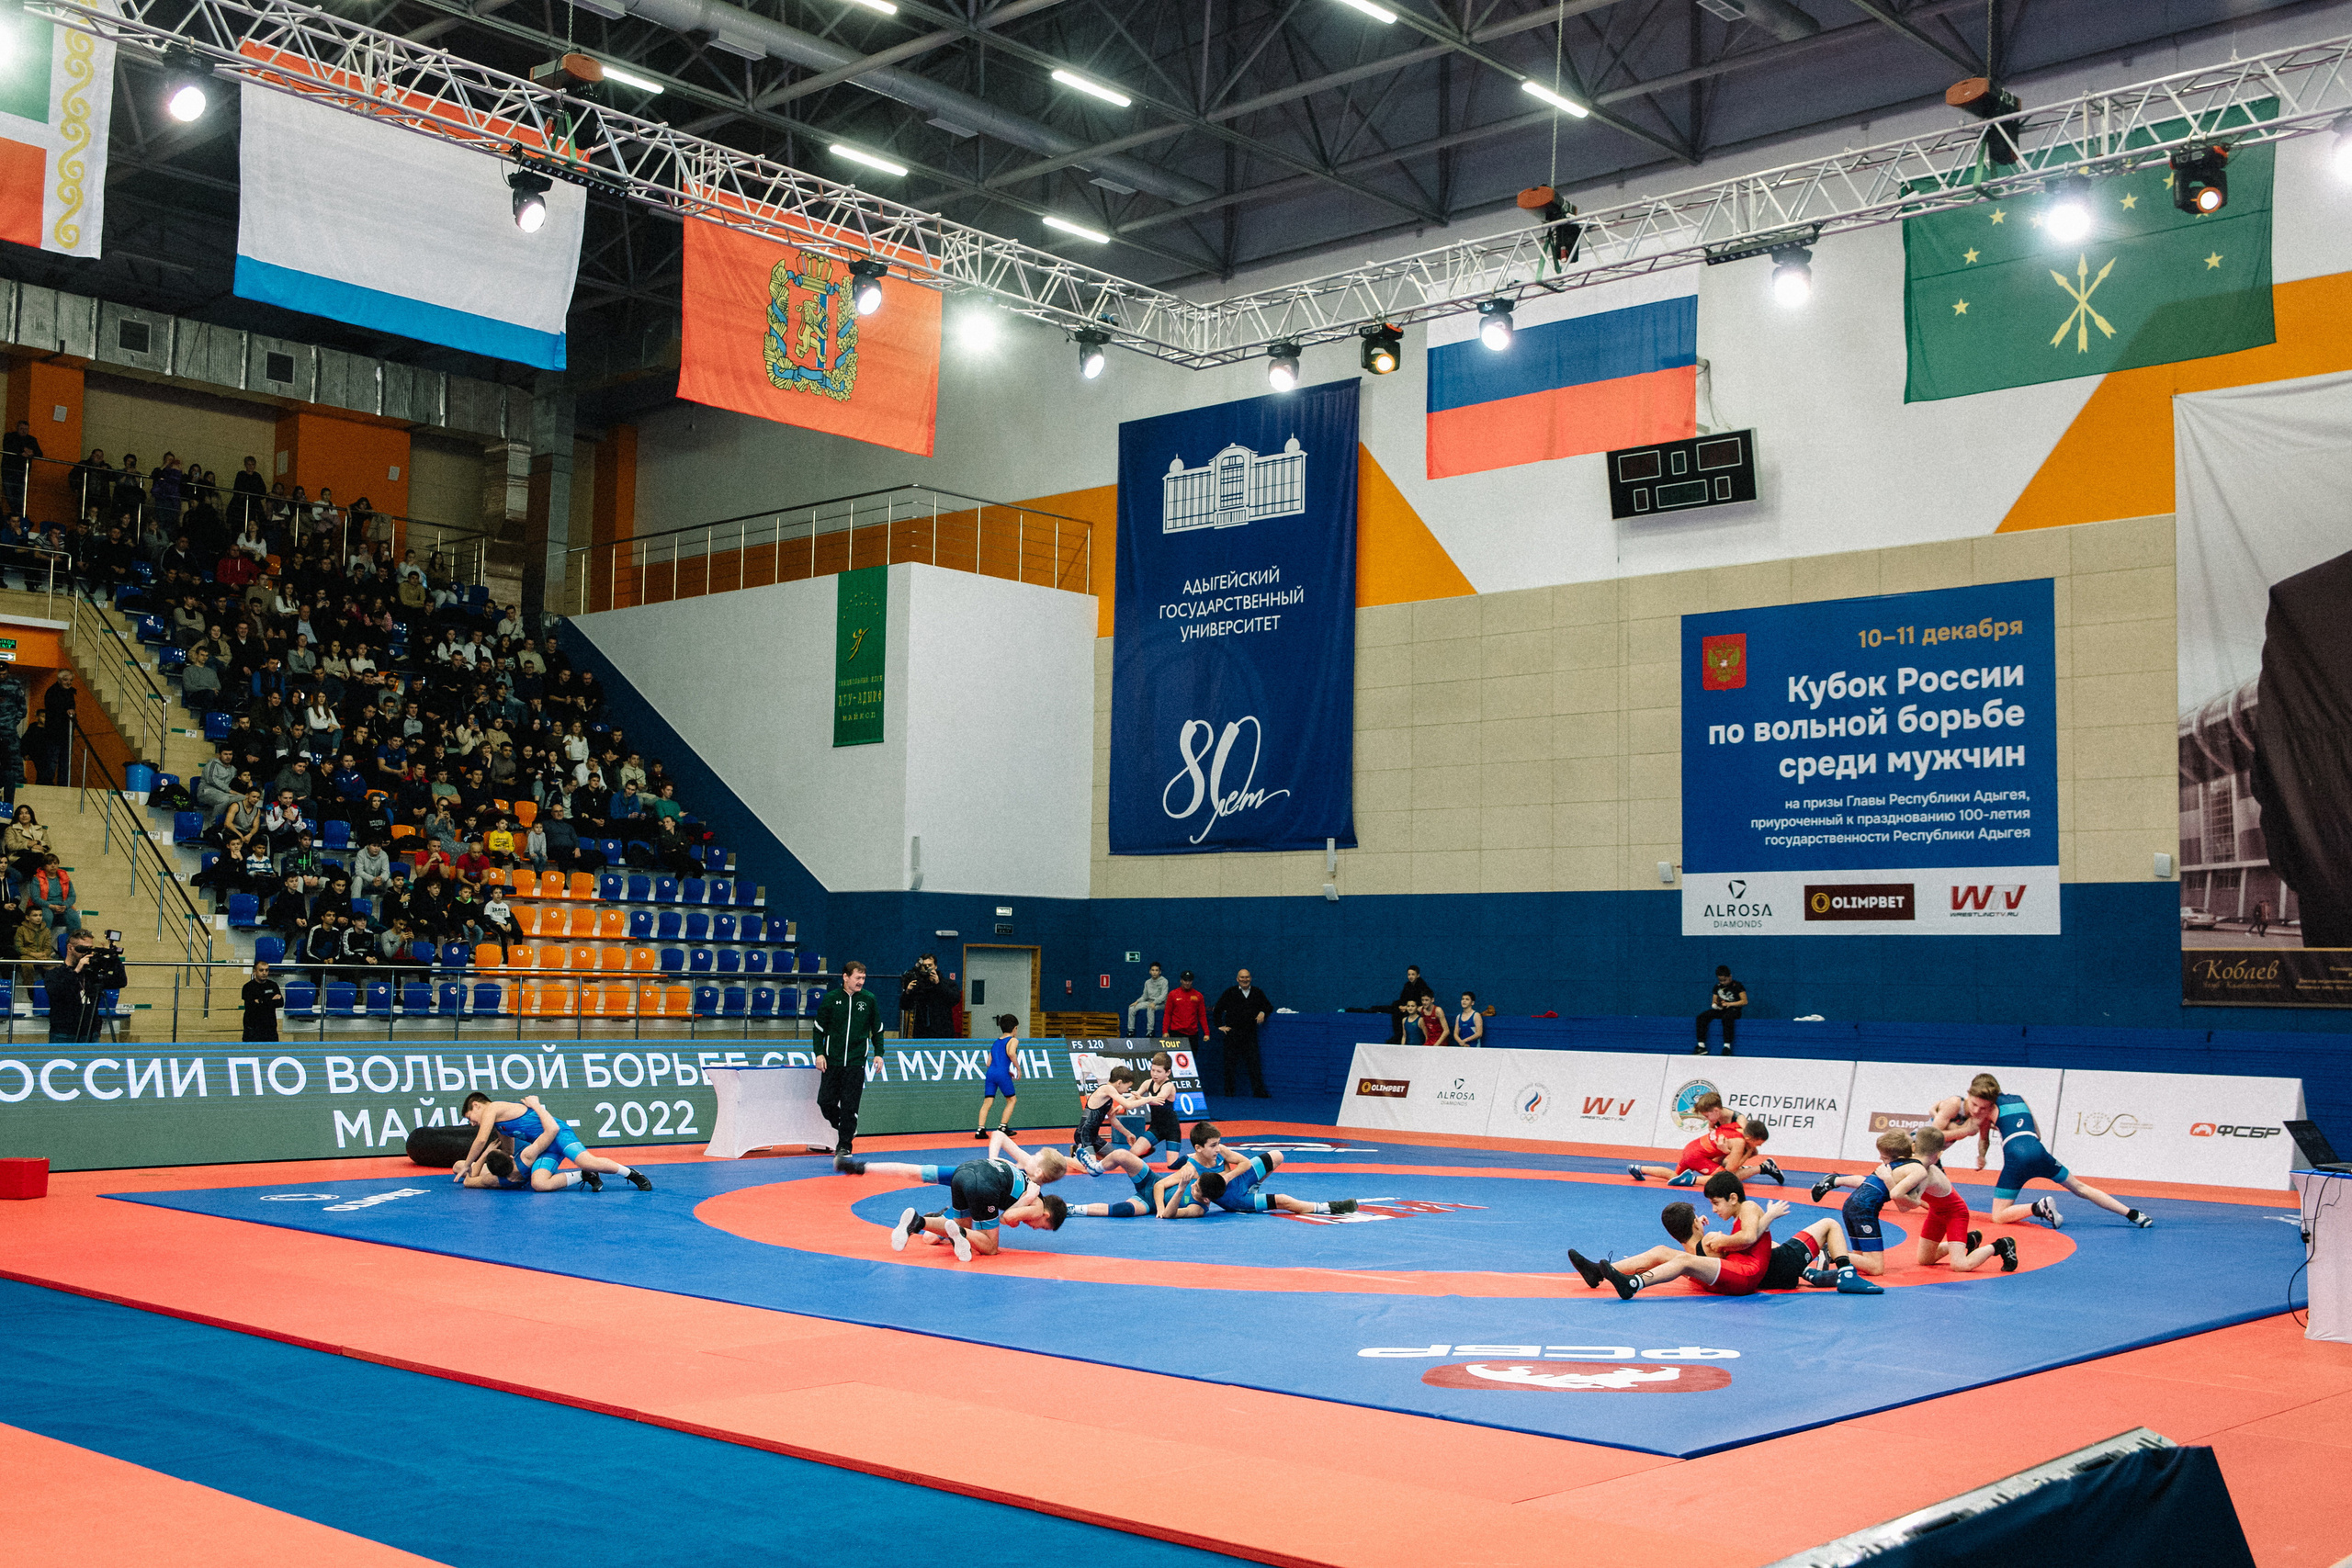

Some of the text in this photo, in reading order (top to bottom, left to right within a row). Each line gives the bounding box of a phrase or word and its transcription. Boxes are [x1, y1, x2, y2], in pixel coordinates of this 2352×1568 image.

[1182, 565, 1280, 595] АДЫГЕЙСКИЙ
[1159, 585, 1305, 619] ГОСУДАРСТВЕННЫЙ
[1180, 615, 1281, 642] УНИВЕРСИТЕТ
[1921, 617, 2024, 647] декабря
[1788, 664, 2025, 710] Кубок России
[1708, 698, 2026, 745] по вольной борьбе
[1162, 716, 1261, 818] 80
[1779, 745, 2026, 784] среди мужчин
[1784, 789, 2030, 812] на призы Главы Республики Адыгея,
[1751, 807, 2030, 831] приуроченный к празднованию 100-летия
[1764, 827, 2031, 848] государственности Республики Адыгея
[1704, 903, 1773, 918] ALROSA
[1831, 895, 1905, 910] OLIMPBET
[1713, 919, 1763, 929] DIAMONDS
[2192, 959, 2279, 980] Коблев
[1071, 1040, 1104, 1049] FS 120
[1125, 1039, 1133, 1050] 0
[1159, 1039, 1181, 1049] Tour
[228, 1056, 307, 1097] ПО
[325, 1043, 569, 1094] ВОЛЬНОЙ
[897, 1049, 1054, 1081] МУЖИН
[1194, 1078, 1202, 1089] 2
[1371, 1084, 1406, 1093] OLIMPBET
[1180, 1093, 1194, 1115] 0
[1436, 1090, 1476, 1100] ALROSA
[1728, 1093, 1838, 1111] РЕСПУБЛИКА
[594, 1100, 698, 1138] 2022
[2217, 1124, 2281, 1139] ФСБР
[1357, 1344, 1741, 1359] ФСБР
